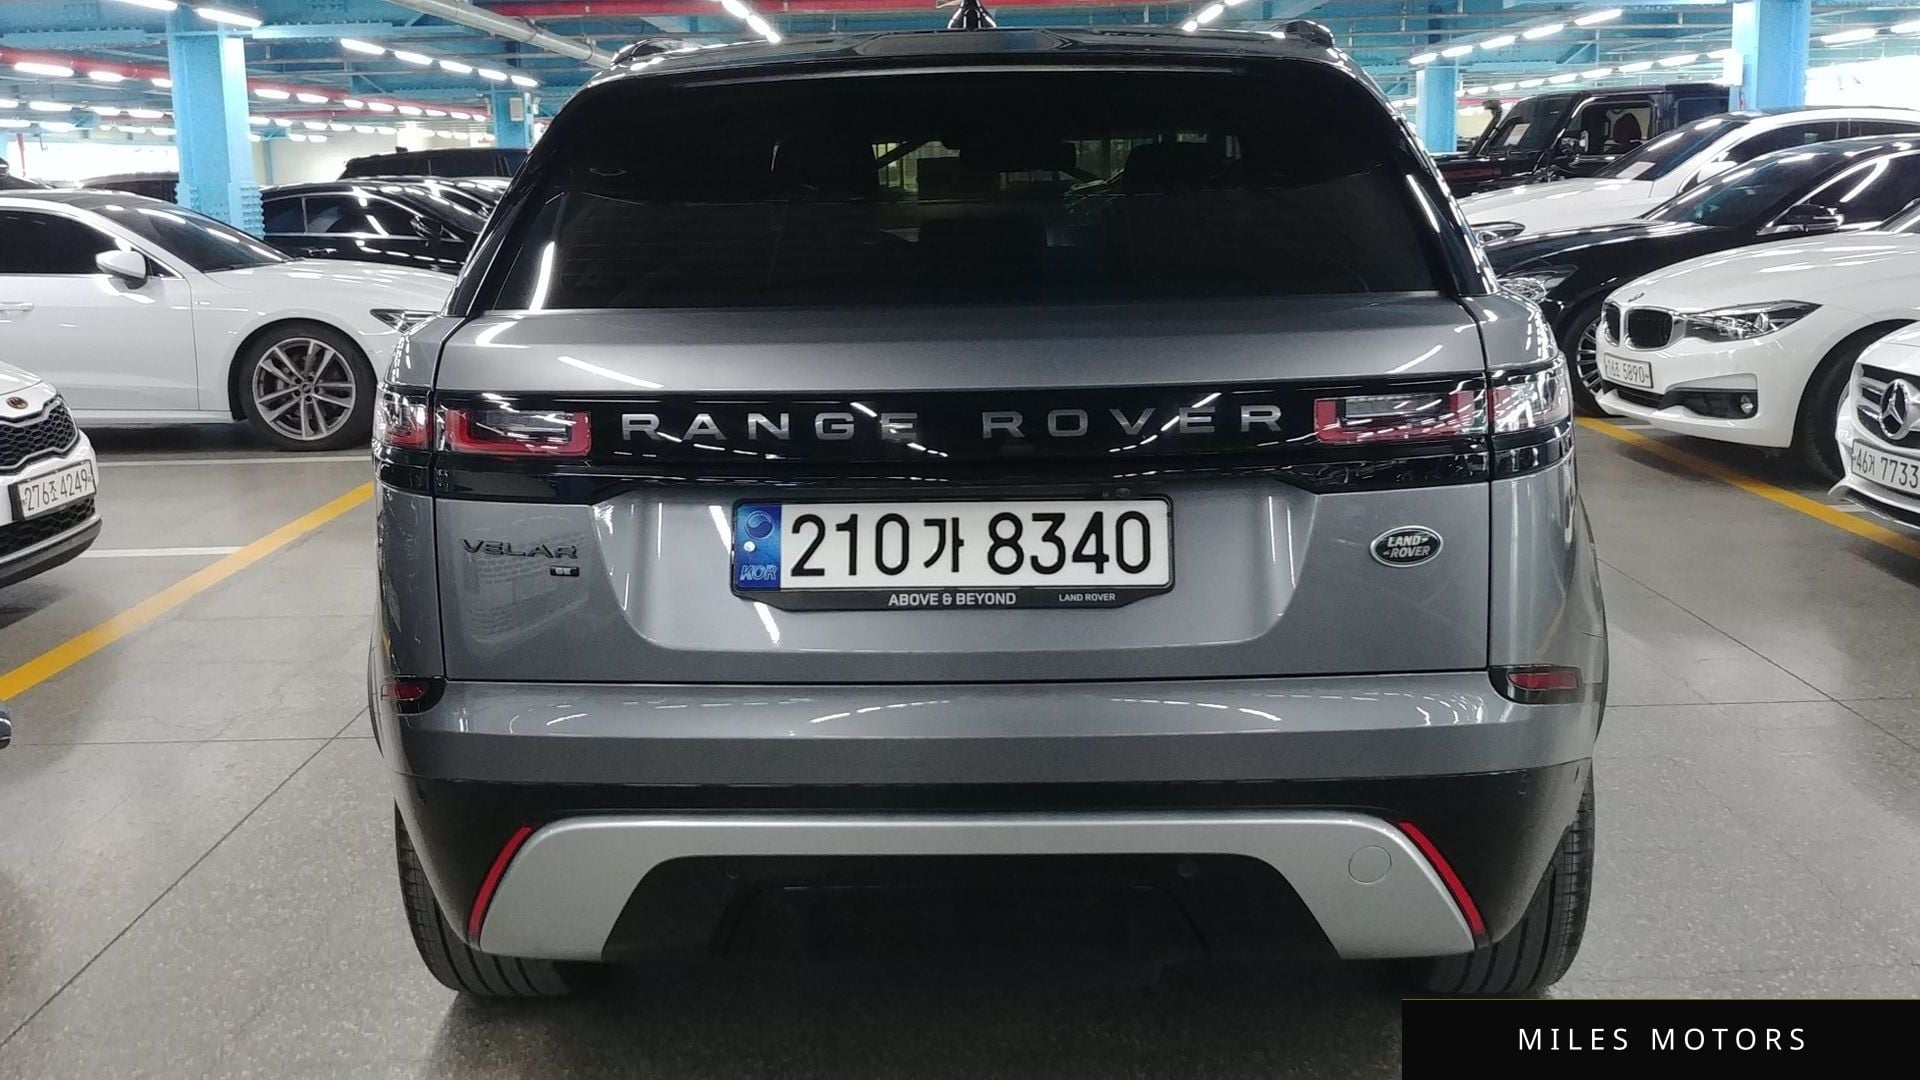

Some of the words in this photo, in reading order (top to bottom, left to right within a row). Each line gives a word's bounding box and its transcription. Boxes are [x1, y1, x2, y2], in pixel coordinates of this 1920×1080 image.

[1623, 363, 1645, 383] 5890
[621, 412, 918, 441] RANGE
[982, 404, 1283, 439] ROVER
[1880, 456, 1919, 489] 7733
[60, 468, 88, 498] 4249
[461, 538, 578, 559] VELAR
[789, 512, 966, 578] 210가
[986, 510, 1152, 576] 8340
[1387, 535, 1421, 548] LAND
[1389, 545, 1431, 558] ROVER
[739, 564, 778, 581] KOR
[888, 592, 939, 606] ABOVE
[942, 593, 953, 605] &
[955, 592, 1017, 606] BEYOND
[1058, 593, 1084, 602] LAND
[1085, 592, 1117, 602] ROVER
